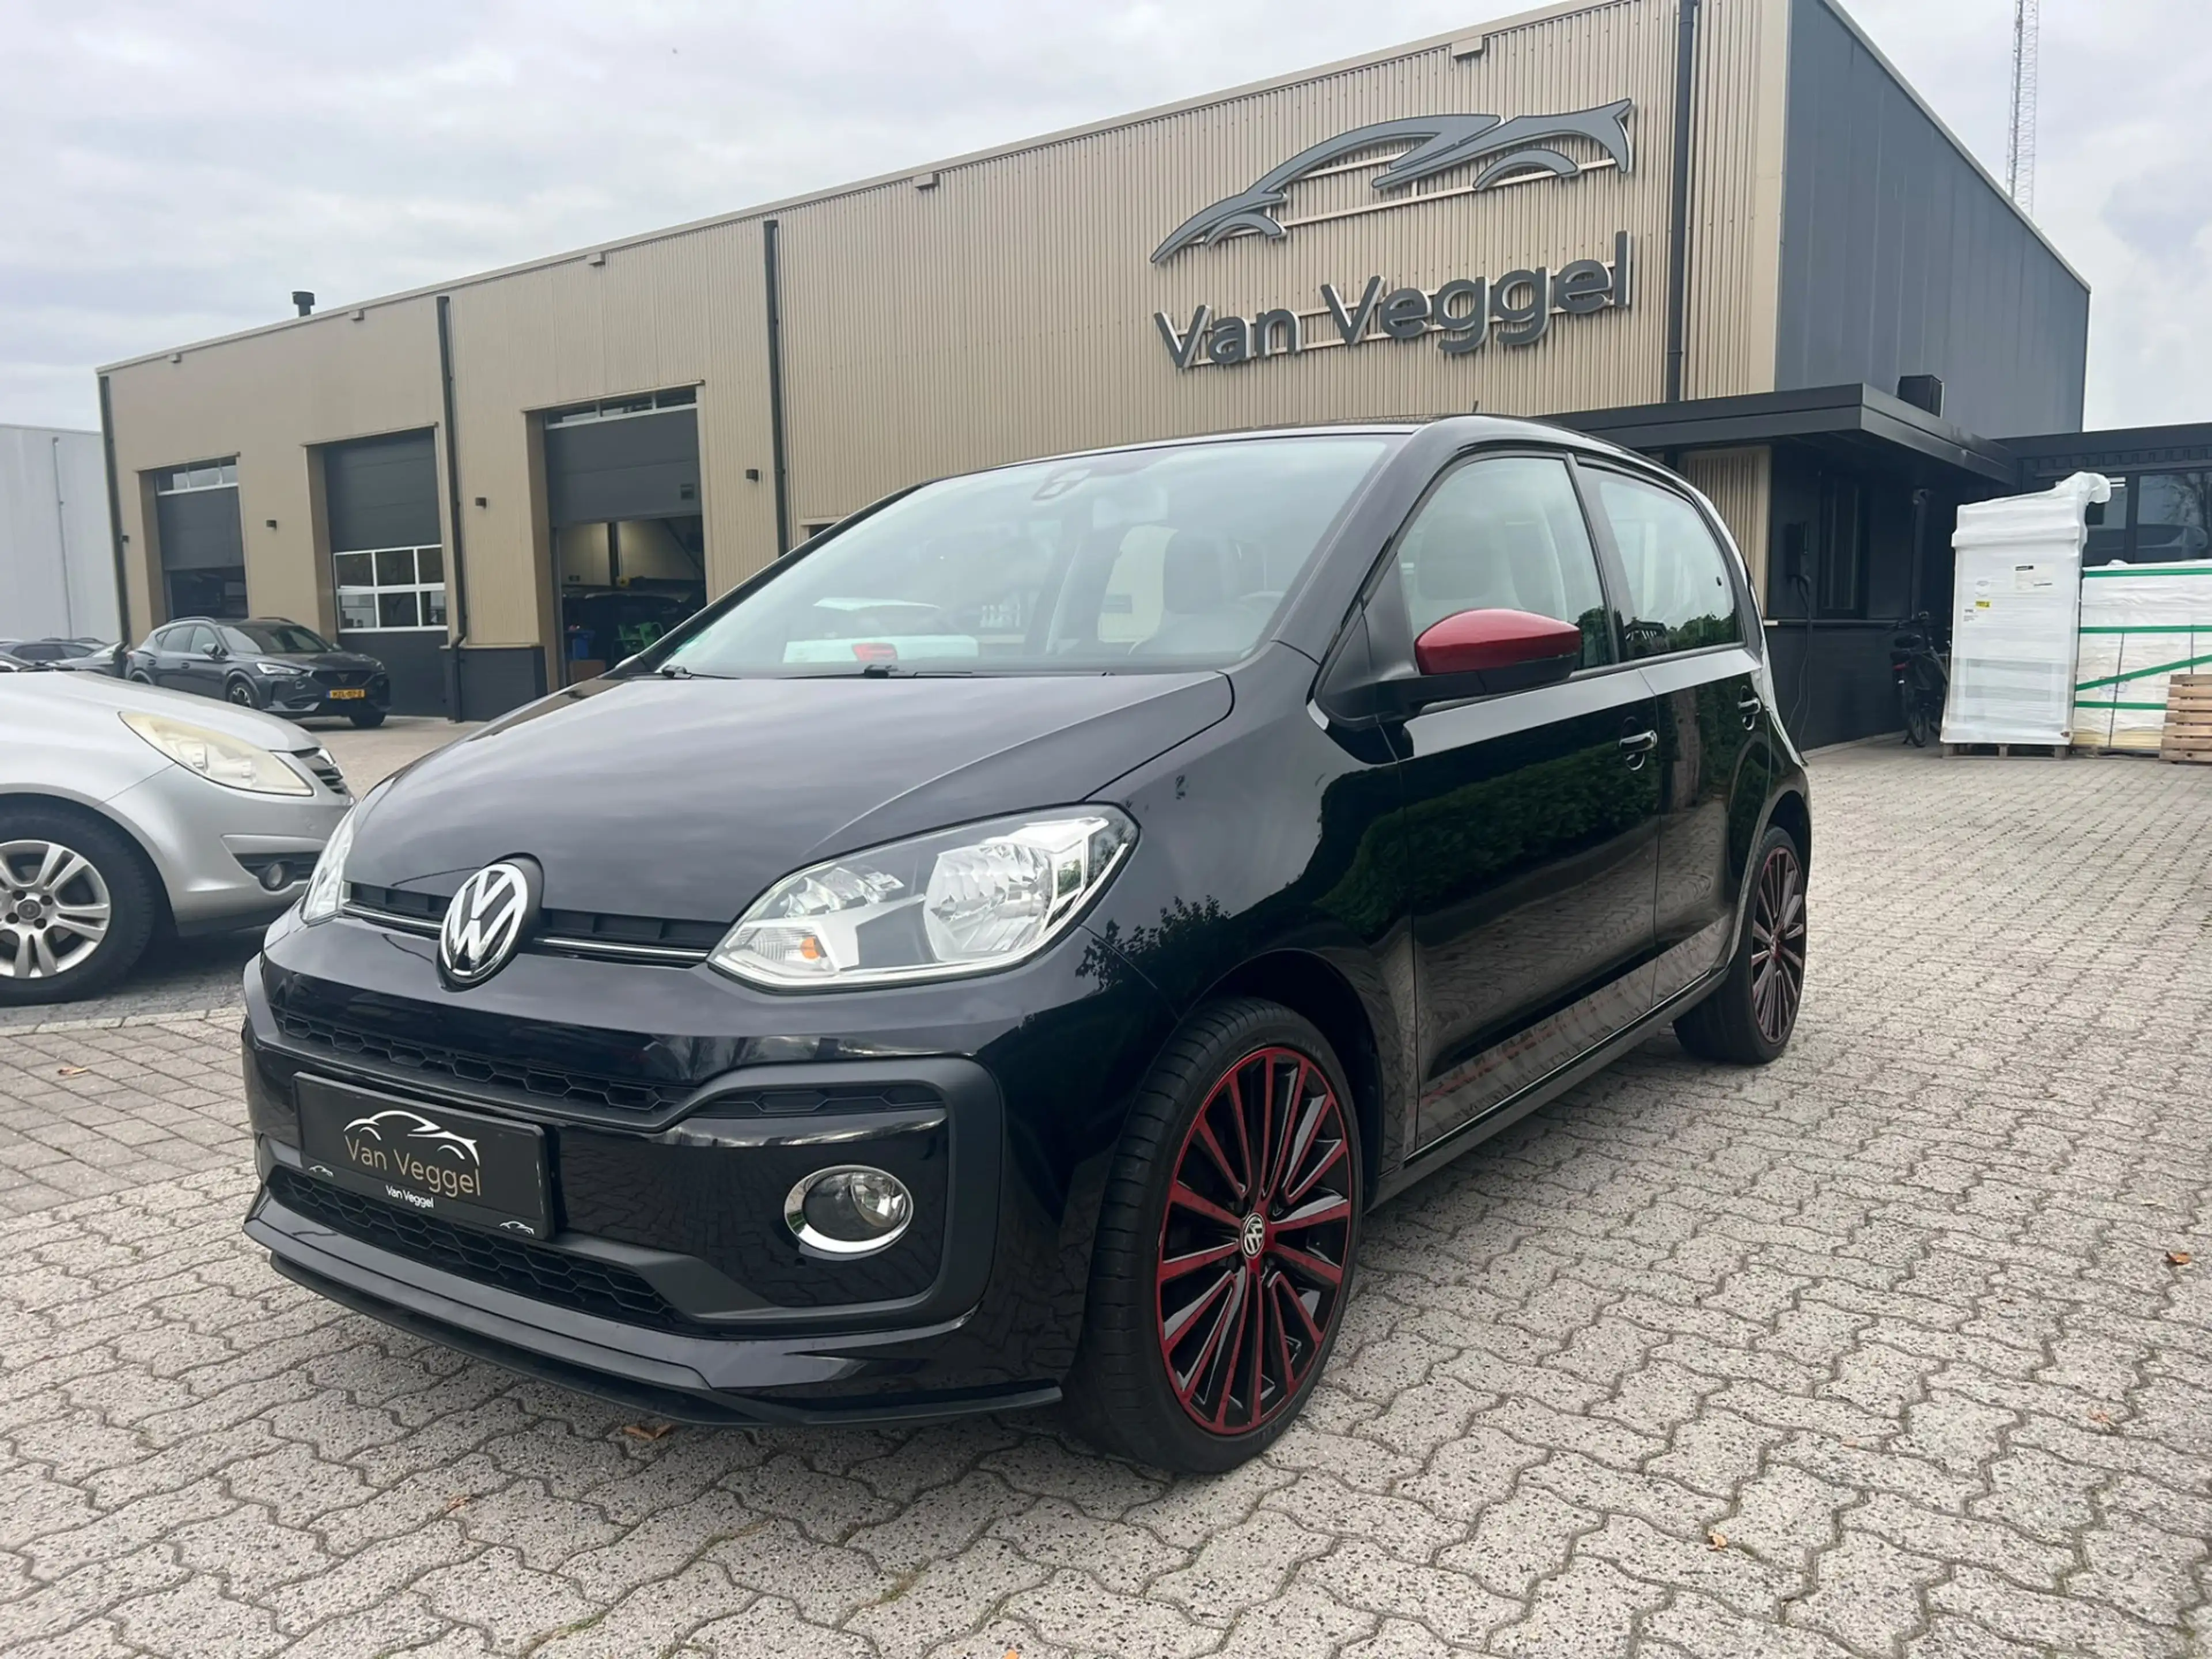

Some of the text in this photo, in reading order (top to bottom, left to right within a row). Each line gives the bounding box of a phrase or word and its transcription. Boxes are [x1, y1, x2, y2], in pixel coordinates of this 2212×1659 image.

[1154, 230, 1633, 369] Van Veggel
[441, 863, 528, 976] VW
[344, 1135, 482, 1197] Van Veggel
[385, 1184, 434, 1209] Van Veggel
